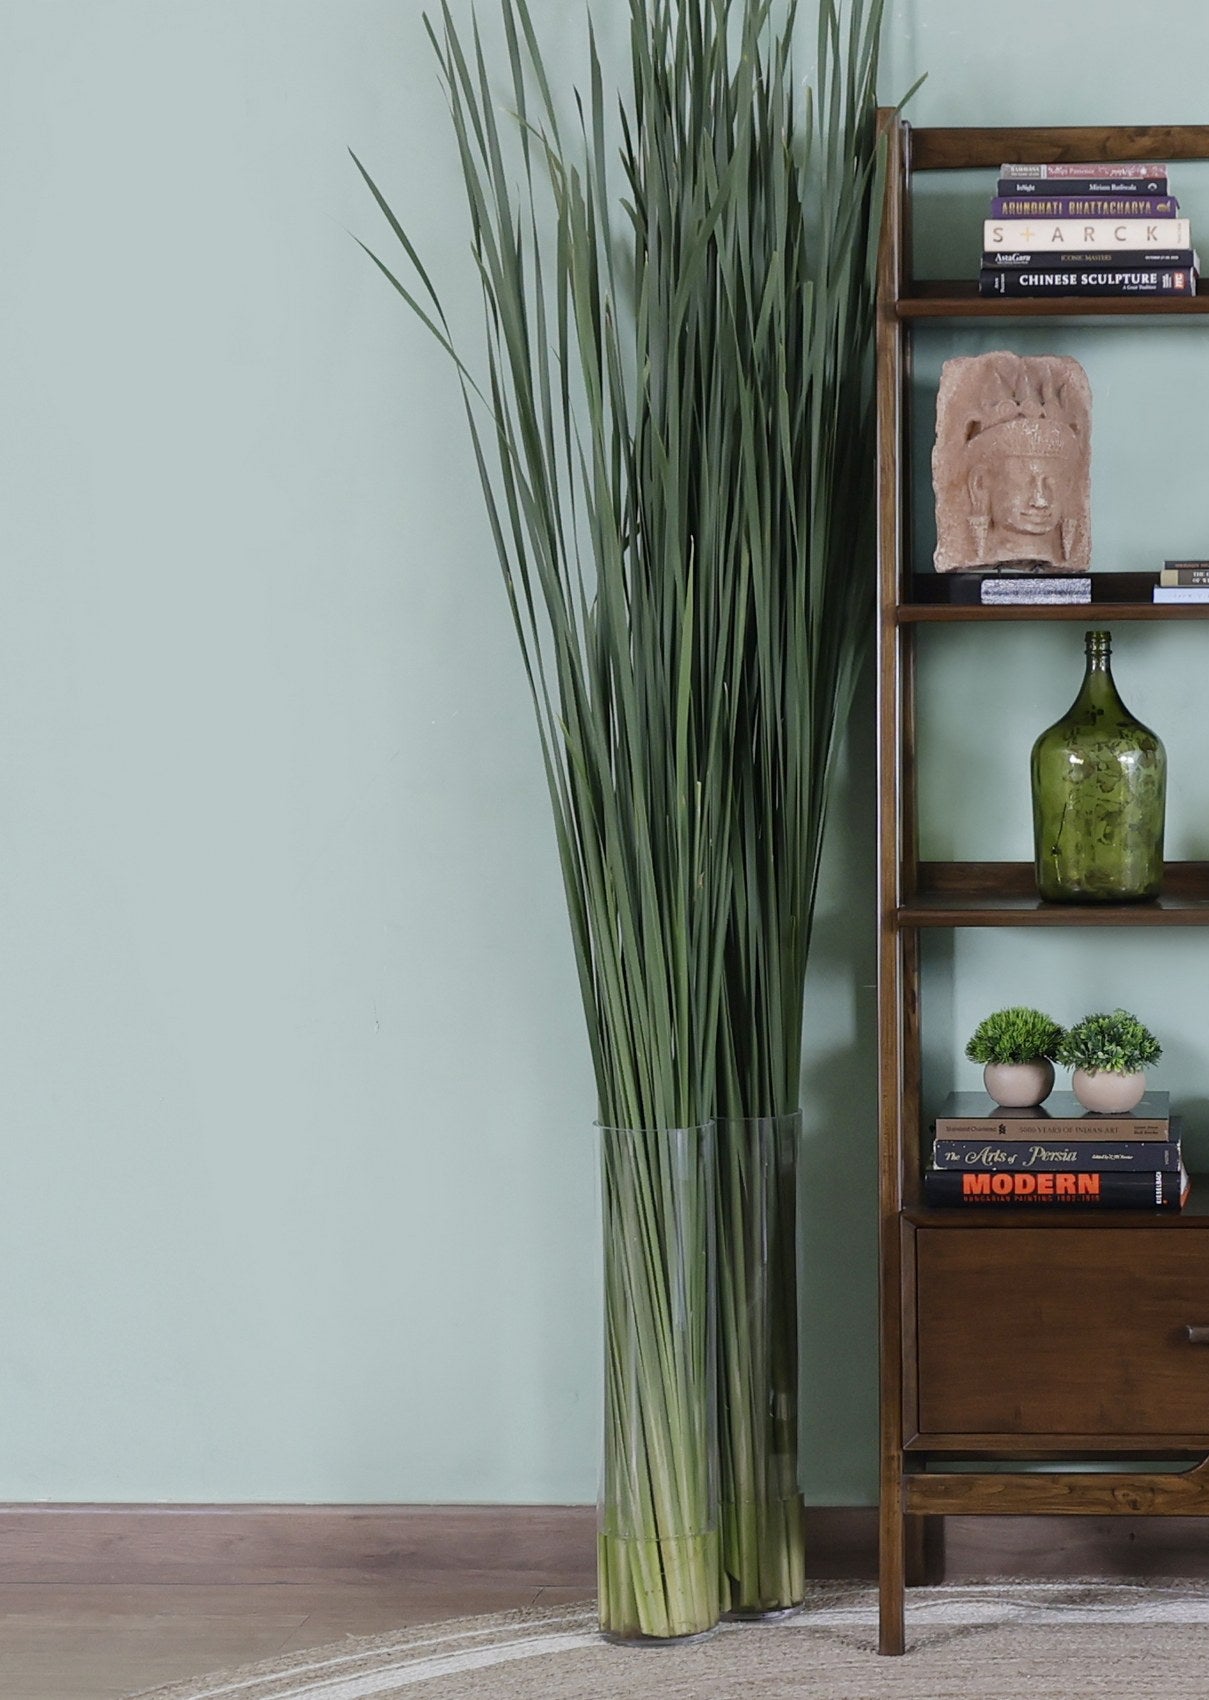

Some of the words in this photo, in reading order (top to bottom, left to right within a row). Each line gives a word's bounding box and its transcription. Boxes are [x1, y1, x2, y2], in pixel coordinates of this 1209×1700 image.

[1002, 201, 1063, 215] ARUNDHATI
[1069, 200, 1151, 215] BHATTACHARYA
[1019, 274, 1077, 286] CHINESE
[1080, 272, 1158, 285] SCULPTURE
[944, 1151, 960, 1161] The
[964, 1145, 1007, 1166] Arts
[1007, 1153, 1018, 1165] of
[1022, 1145, 1078, 1166] Persia
[962, 1173, 1100, 1195] MODERN
[963, 1194, 1011, 1202] HUNGARIAN
[1014, 1194, 1053, 1202] PAINTING
